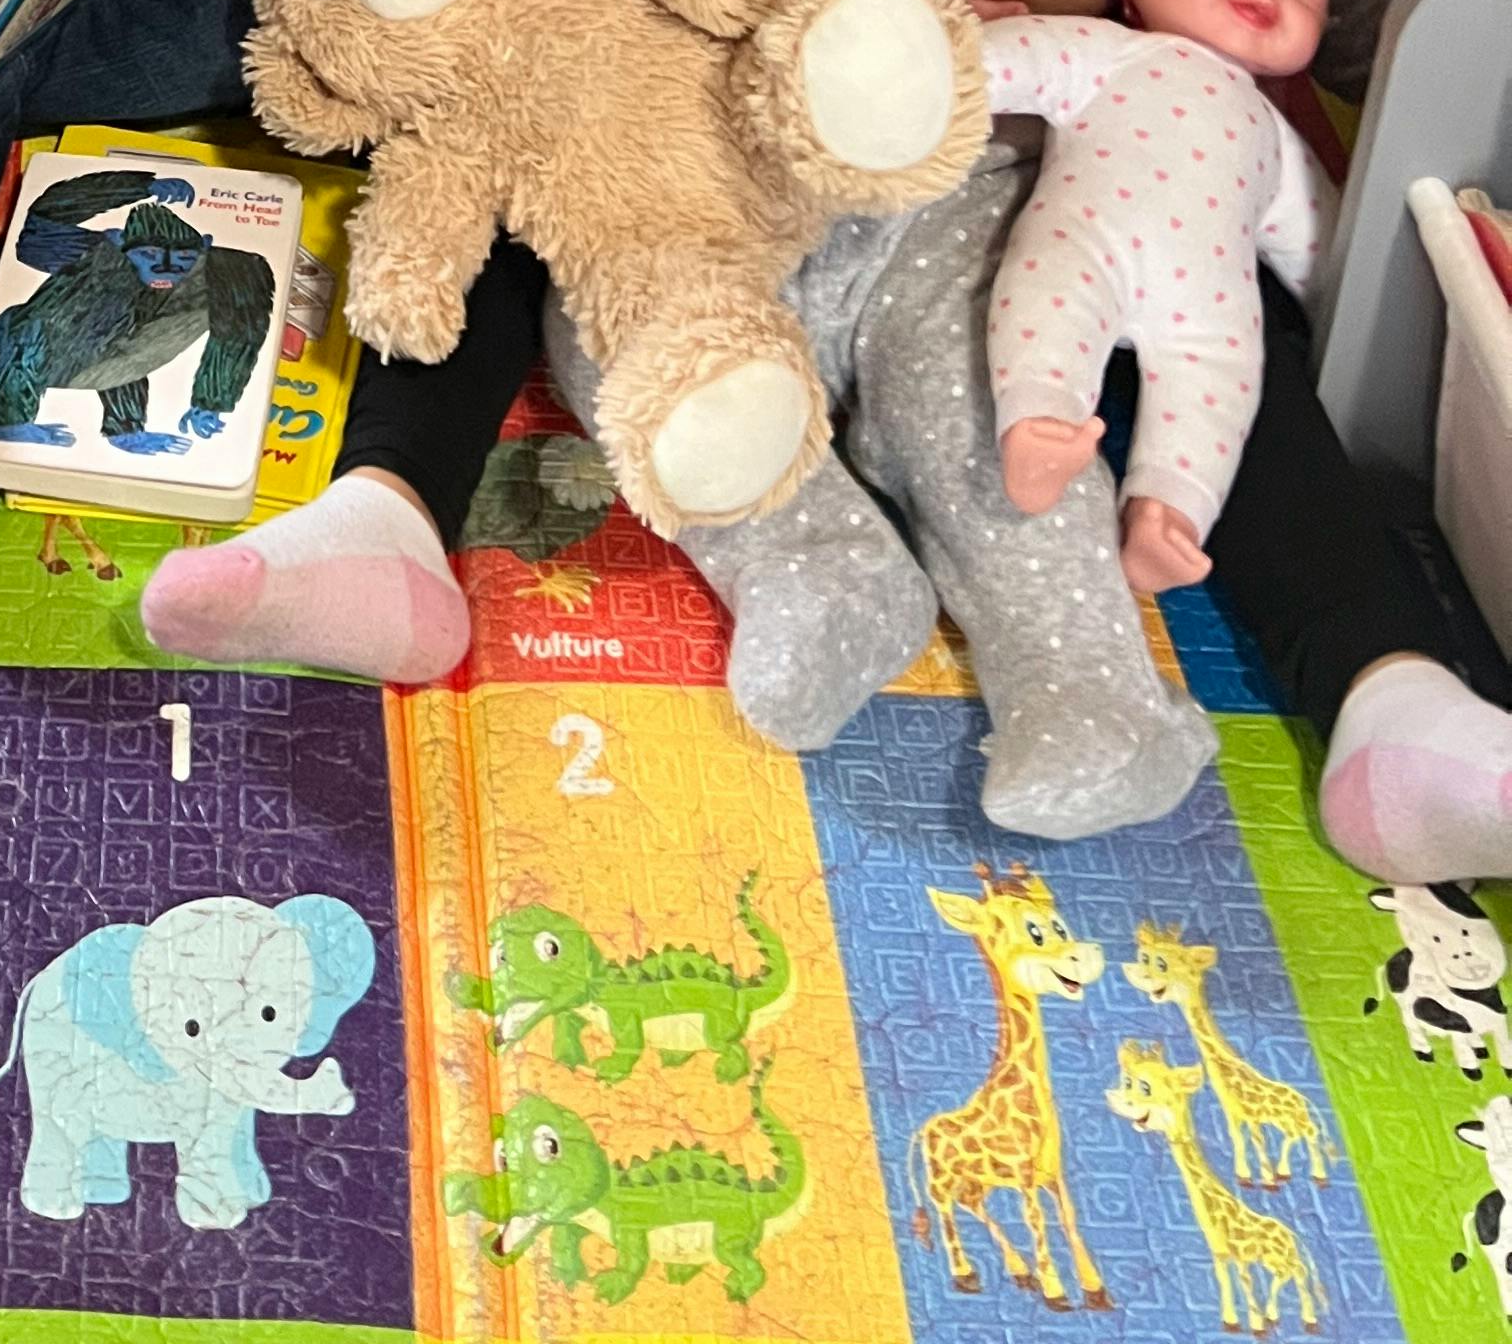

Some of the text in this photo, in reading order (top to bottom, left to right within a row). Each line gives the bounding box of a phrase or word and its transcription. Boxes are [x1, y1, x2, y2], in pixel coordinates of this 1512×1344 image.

[198, 198, 283, 216] From Head
[210, 187, 284, 204] Eric Carle
[234, 214, 281, 227] to Toe
[510, 630, 625, 659] Vulture
[158, 702, 192, 782] 1
[549, 713, 615, 798] 2
